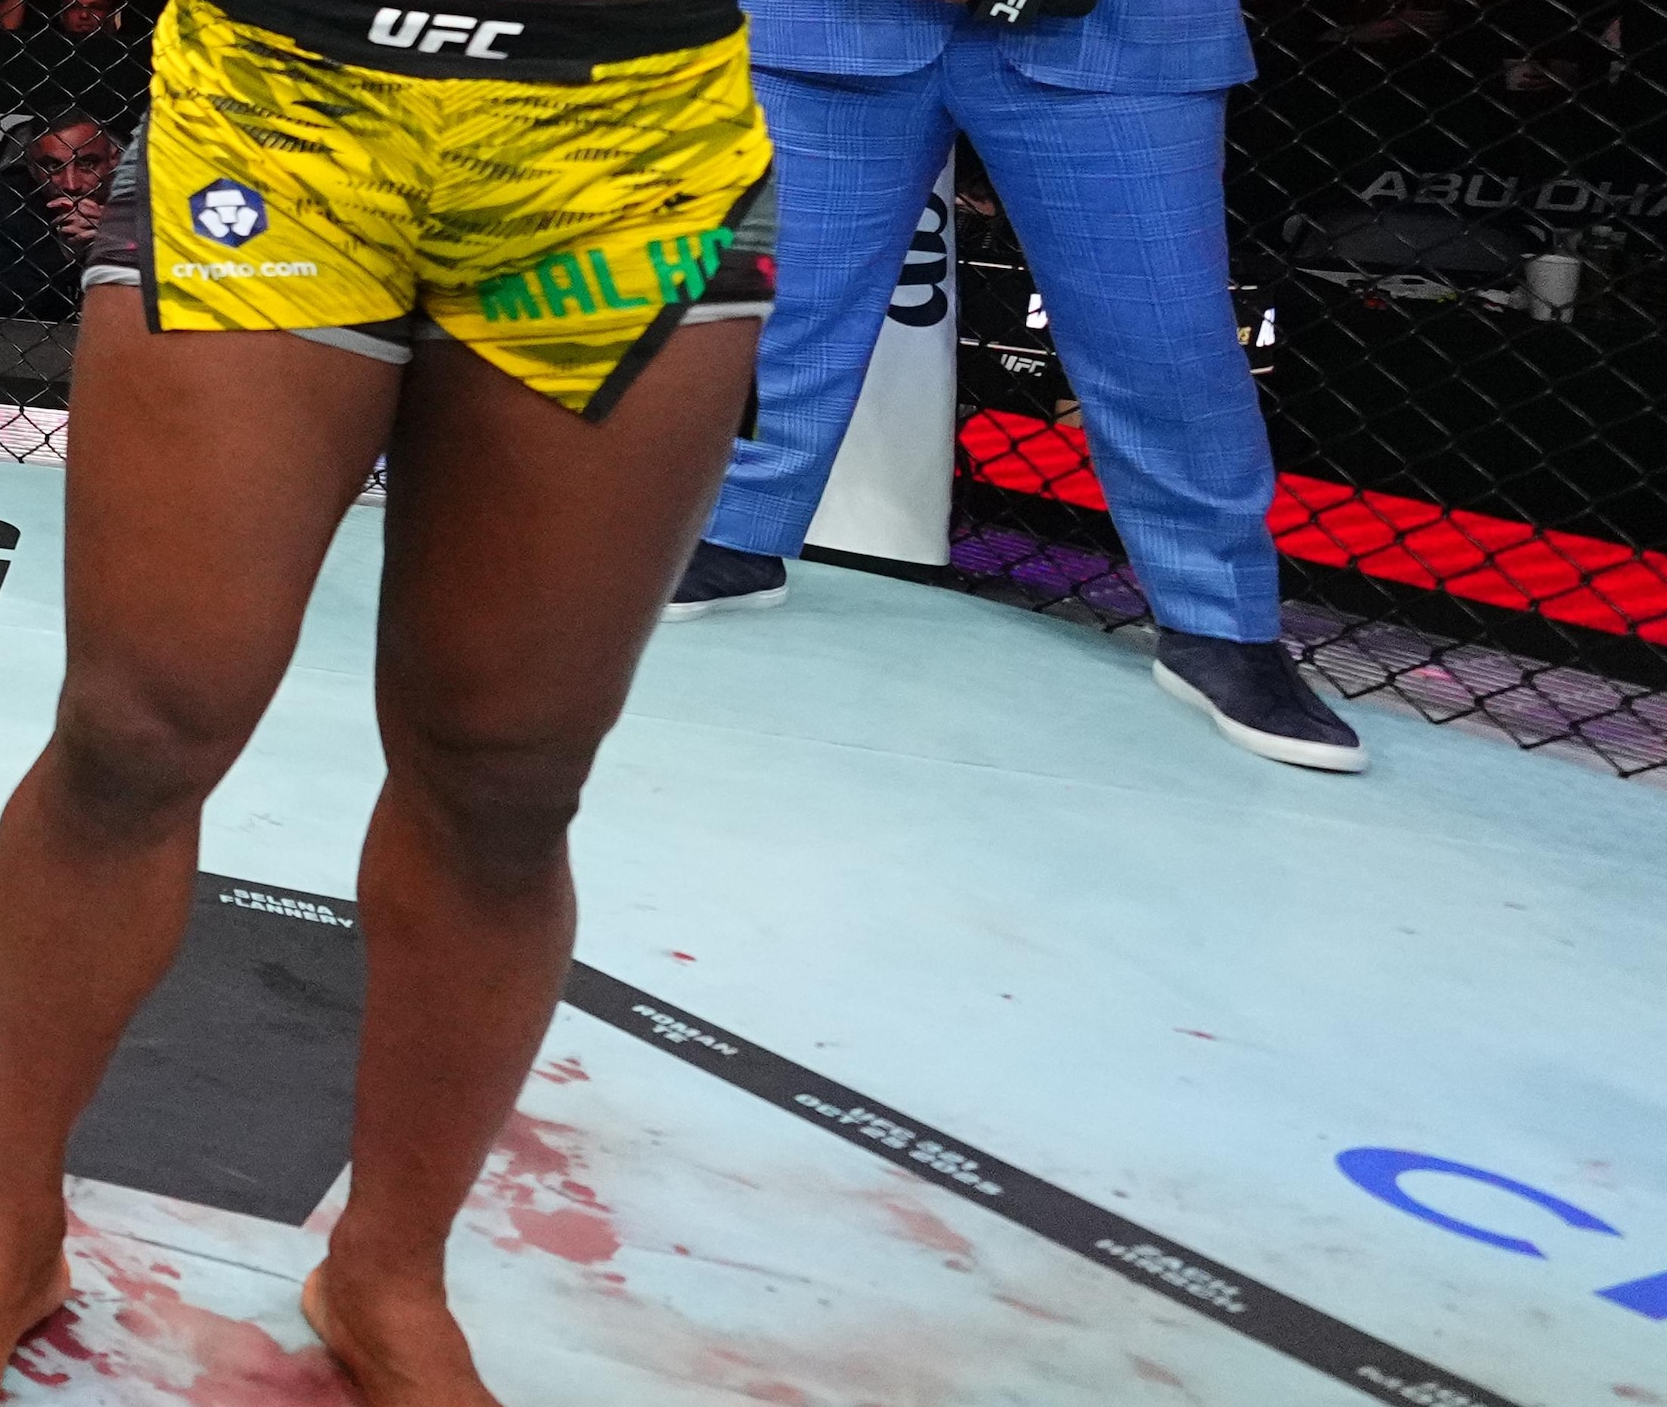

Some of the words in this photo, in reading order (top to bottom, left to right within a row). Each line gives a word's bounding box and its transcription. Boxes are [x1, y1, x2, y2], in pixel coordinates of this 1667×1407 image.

[367, 7, 524, 60] UFC
[1361, 170, 1519, 208] ABU
[170, 258, 318, 283] crypto.com
[1000, 354, 1047, 377] UFC
[219, 894, 354, 928] FLANNERY
[233, 888, 334, 916] SELENA
[631, 1004, 739, 1056] ROMAN
[653, 1025, 688, 1043] TE
[794, 1093, 860, 1125] OCT
